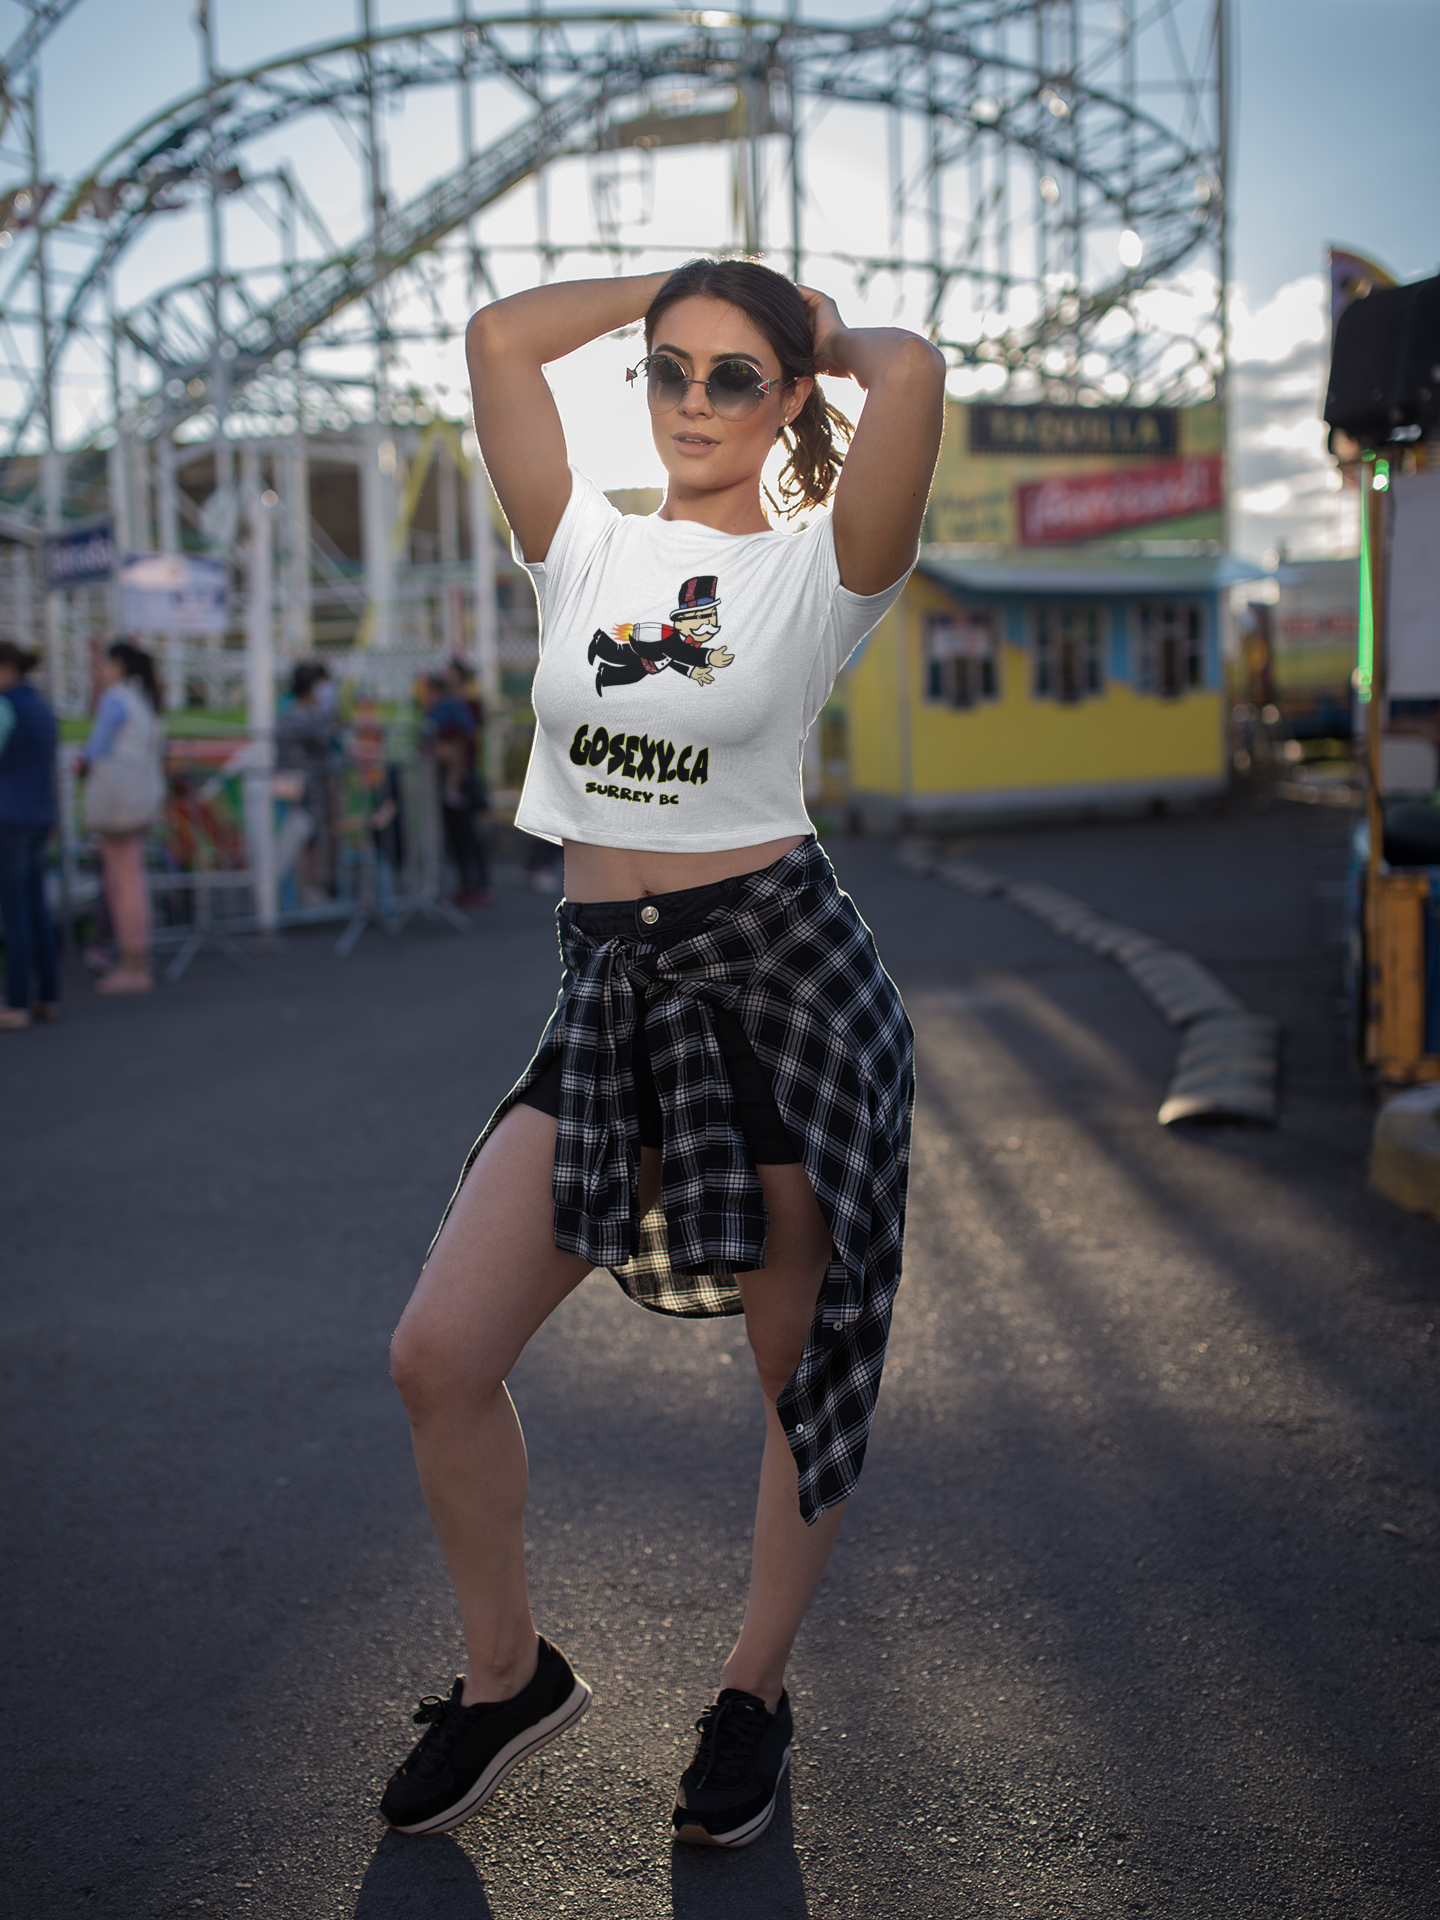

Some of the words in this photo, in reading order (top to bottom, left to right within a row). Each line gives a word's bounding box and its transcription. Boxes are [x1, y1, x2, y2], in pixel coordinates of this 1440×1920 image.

[569, 724, 709, 786] GOSEXY.CA
[585, 782, 655, 804] SURREY
[659, 794, 679, 806] BC
